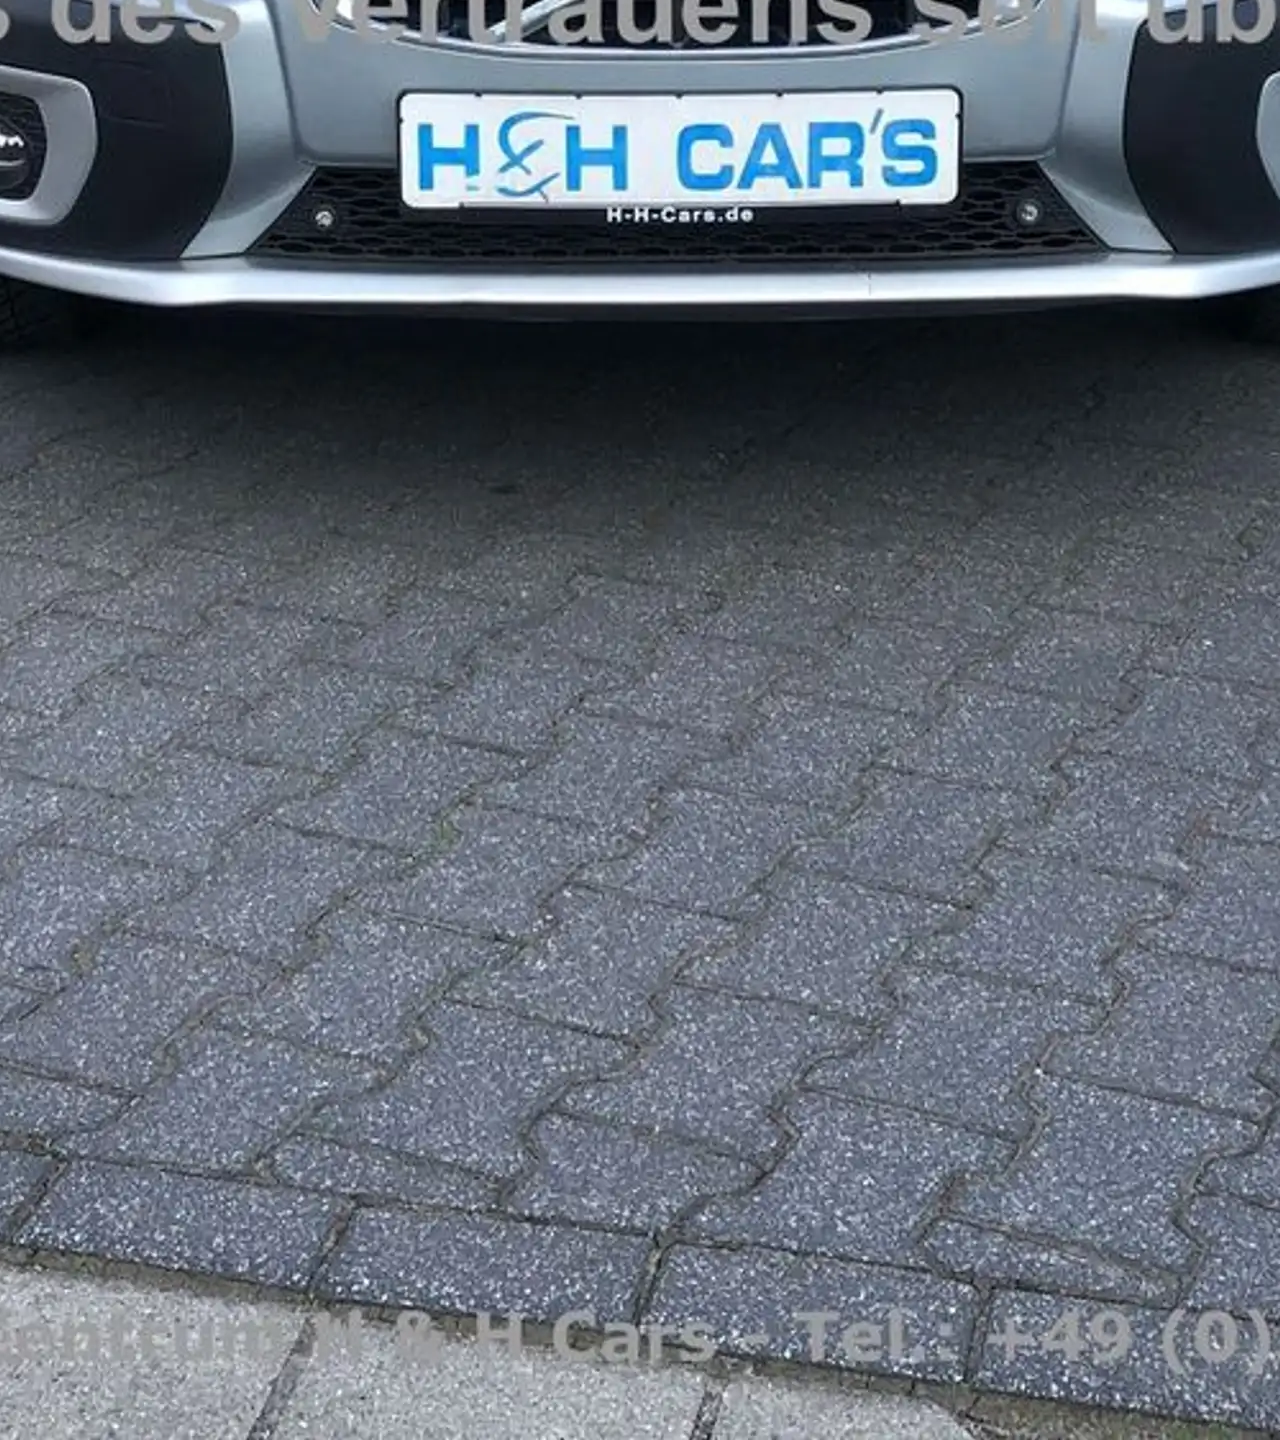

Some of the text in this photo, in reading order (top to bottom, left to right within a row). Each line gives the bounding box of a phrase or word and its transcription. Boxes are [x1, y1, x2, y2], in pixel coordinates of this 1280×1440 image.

[417, 109, 938, 203] H&H CAR'S
[606, 206, 754, 224] H-H-Cars.de
